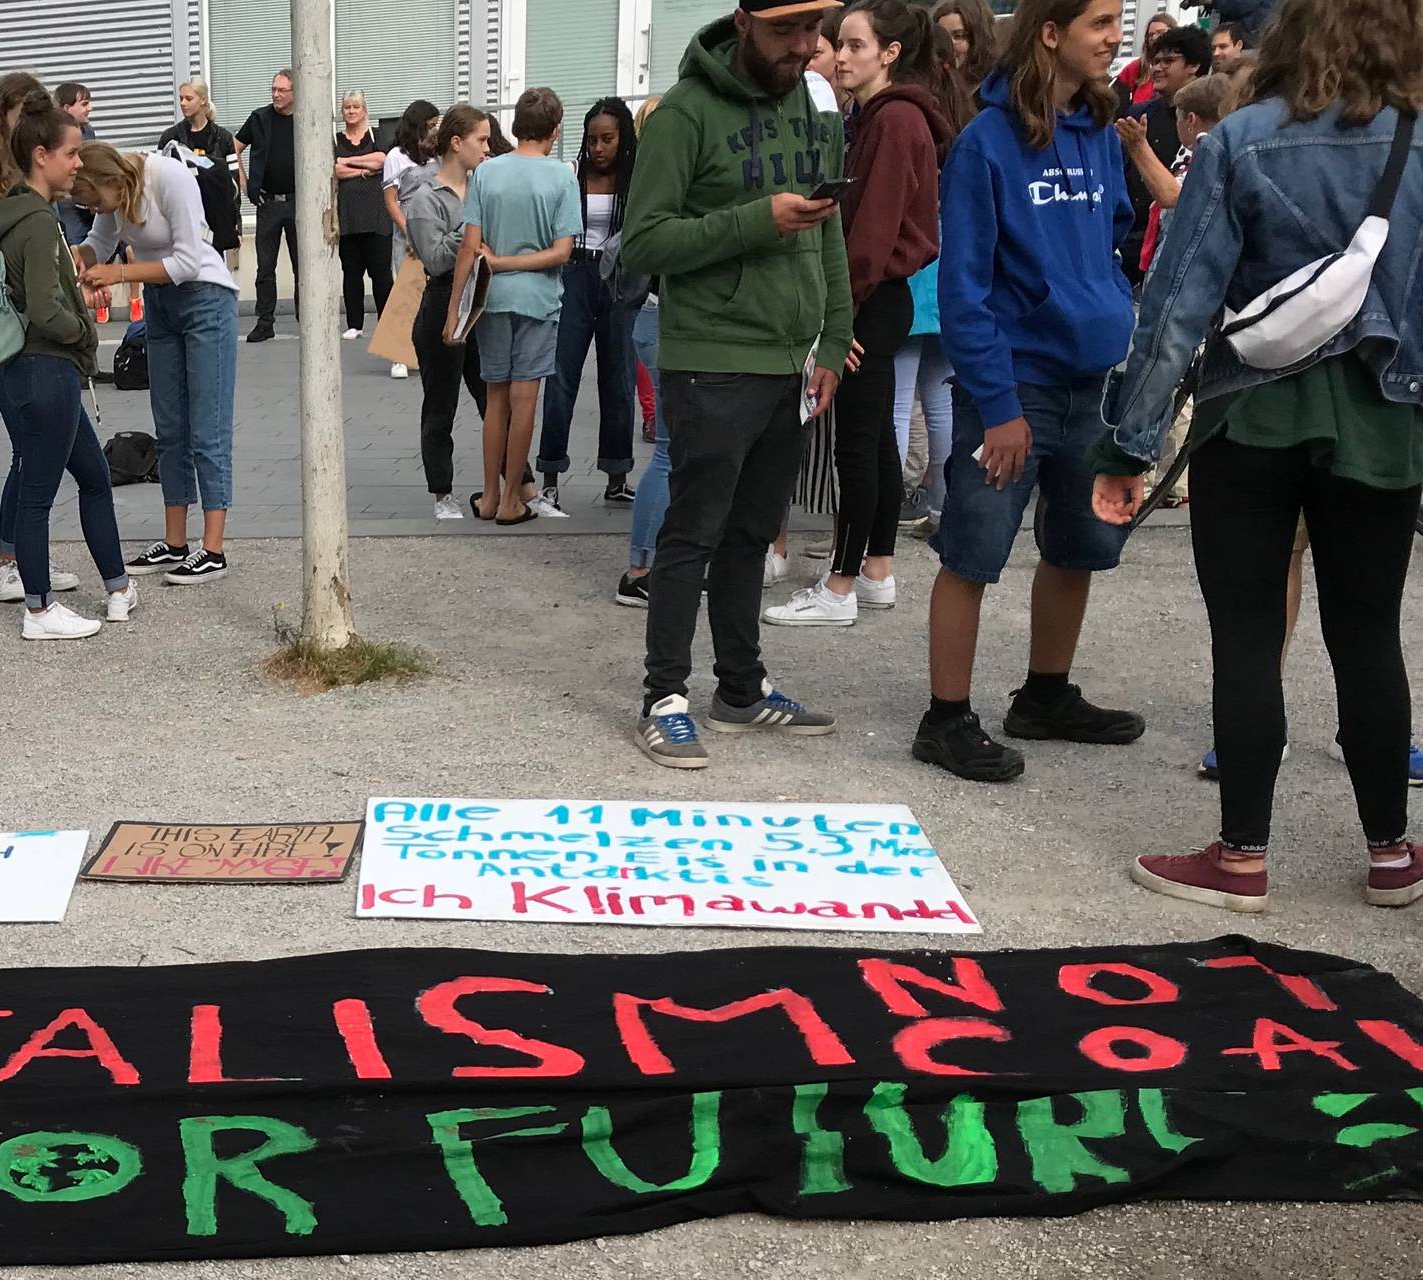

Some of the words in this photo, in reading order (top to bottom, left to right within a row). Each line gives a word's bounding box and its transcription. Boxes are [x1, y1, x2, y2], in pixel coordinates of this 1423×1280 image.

[373, 801, 500, 822] Alle
[544, 804, 603, 824] 11
[630, 807, 921, 836] Minuten
[147, 826, 219, 843] THIS
[229, 826, 335, 844] EARTH
[381, 824, 733, 850] Schmelzen
[124, 842, 166, 856] IS
[179, 842, 226, 858] ON
[381, 843, 599, 863] Tonnen
[625, 852, 726, 869] Eis
[753, 854, 809, 873] in
[834, 860, 935, 878] der
[477, 862, 775, 887] Antarktis
[361, 883, 473, 910] Ich
[857, 955, 1339, 1018] NOT
